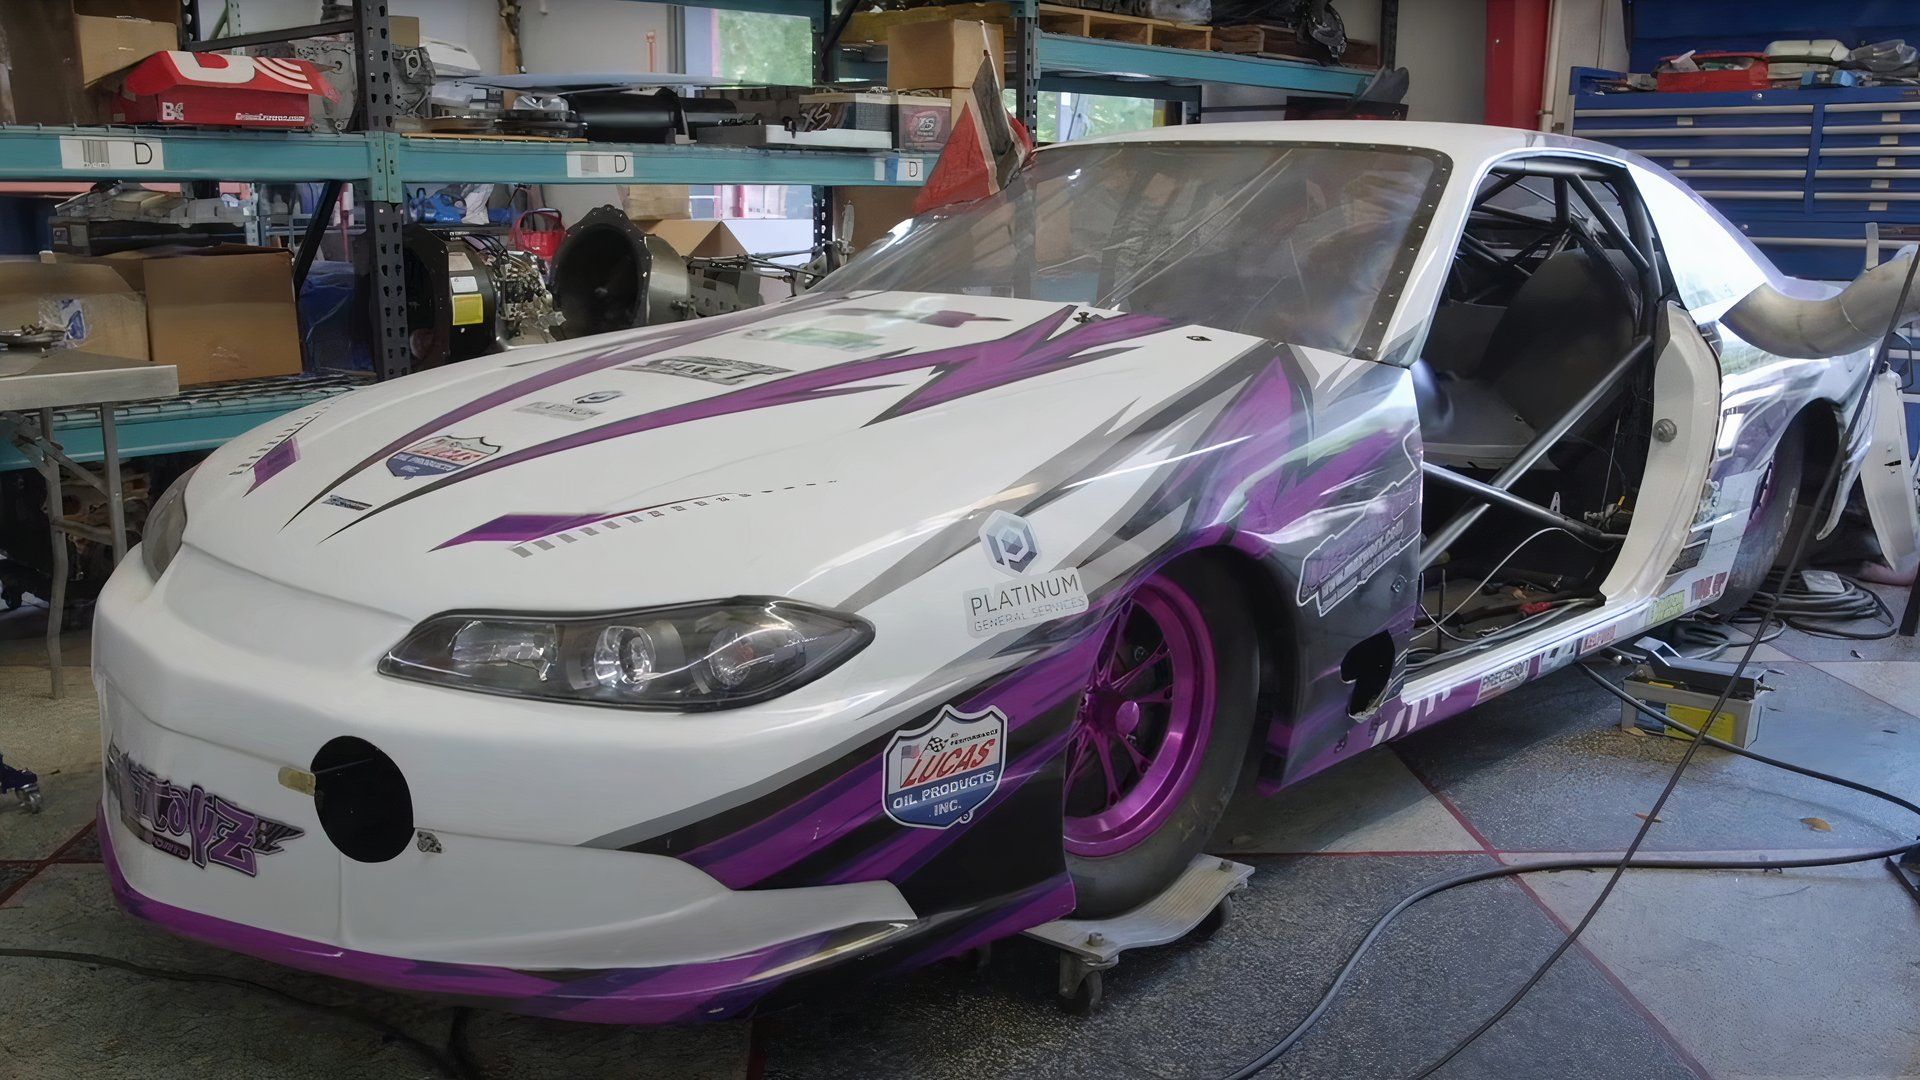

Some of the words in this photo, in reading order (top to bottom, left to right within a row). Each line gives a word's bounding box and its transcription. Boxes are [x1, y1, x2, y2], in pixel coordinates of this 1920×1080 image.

[134, 142, 153, 165] D
[614, 155, 627, 173] D
[909, 161, 918, 177] D
[971, 574, 1079, 616] PLATINUM
[974, 611, 1027, 632] GENERAL
[1032, 596, 1086, 618] SERVICES
[900, 739, 996, 788] LUCAS
[893, 794, 918, 809] OIL
[922, 770, 995, 802] PRODUCTS
[933, 799, 962, 817] INC.
